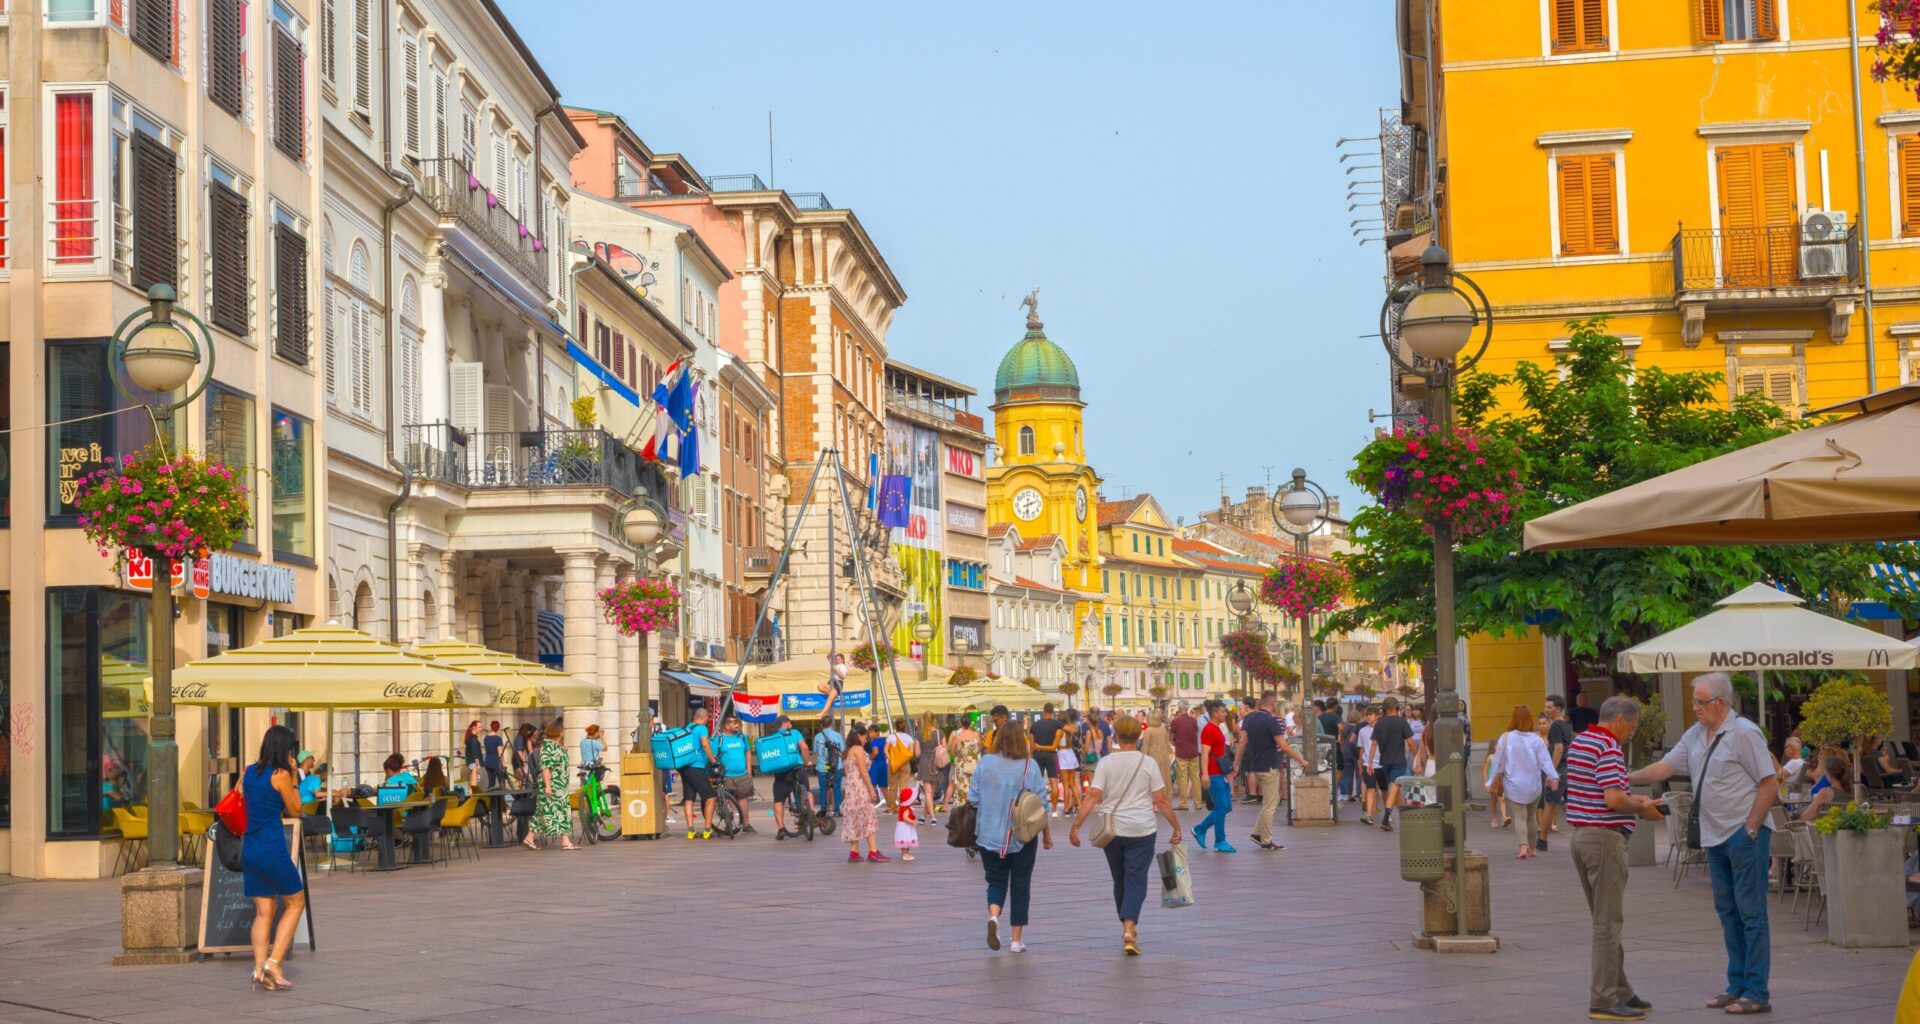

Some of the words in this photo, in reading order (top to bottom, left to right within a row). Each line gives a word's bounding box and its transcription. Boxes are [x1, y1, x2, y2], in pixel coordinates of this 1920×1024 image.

[949, 447, 973, 476] NKD
[905, 513, 927, 540] NKD
[128, 559, 184, 578] KIG
[193, 570, 209, 588] KING
[212, 554, 265, 600] BURGER
[266, 566, 296, 604] KING
[1709, 650, 1834, 668] McDonald's
[677, 742, 693, 754] Wolt
[761, 748, 780, 760] Wolt
